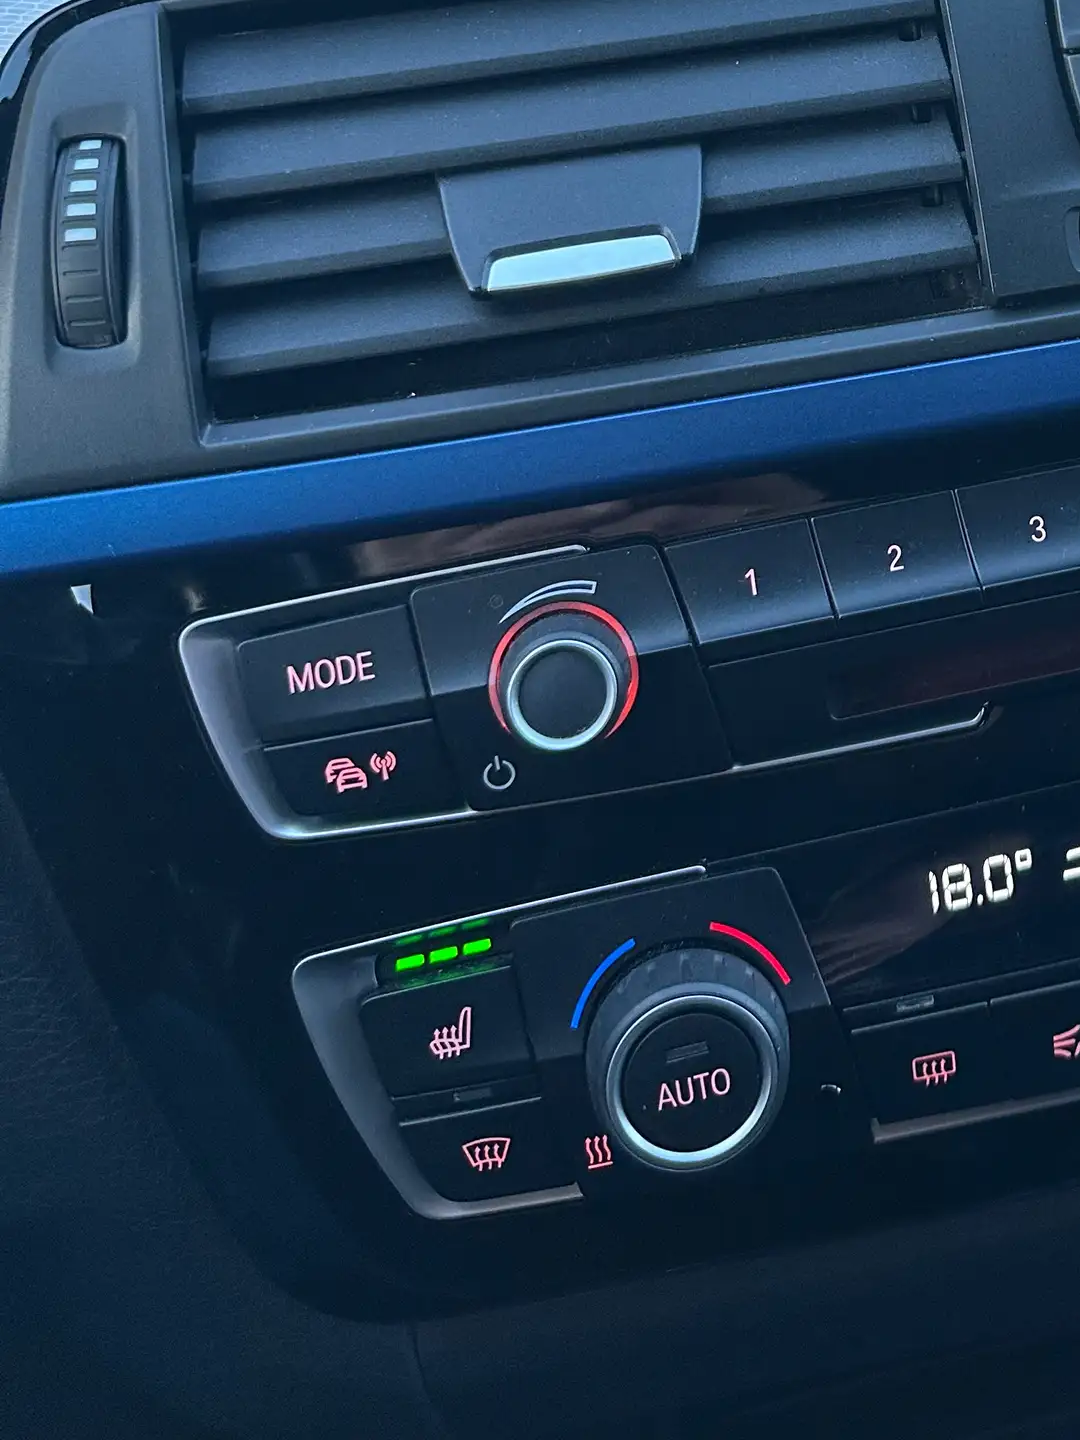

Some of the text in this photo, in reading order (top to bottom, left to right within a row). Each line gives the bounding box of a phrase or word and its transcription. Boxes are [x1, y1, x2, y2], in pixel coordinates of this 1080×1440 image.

[1029, 515, 1047, 543] 3
[887, 545, 905, 572] 2
[743, 568, 758, 596] 1
[286, 650, 376, 695] MODE
[656, 1067, 732, 1112] AUTO
